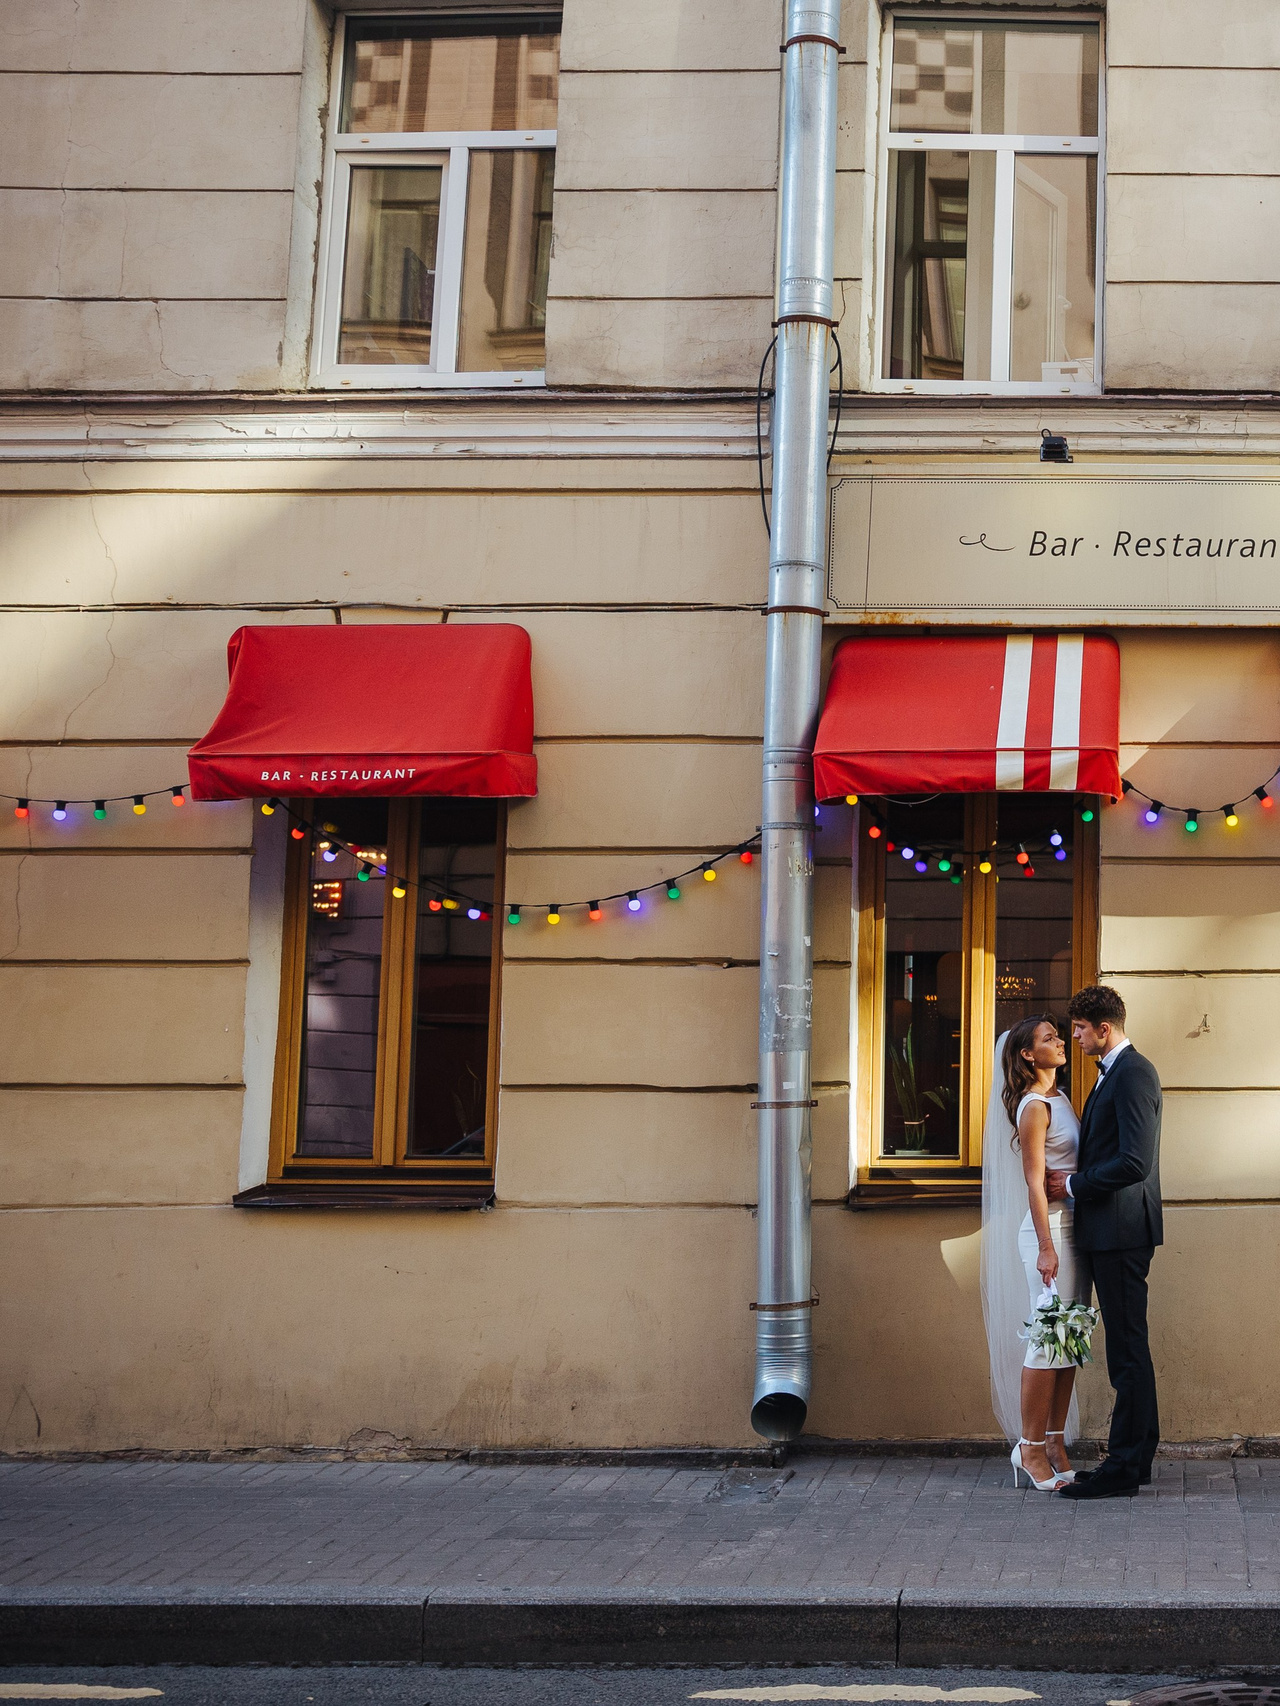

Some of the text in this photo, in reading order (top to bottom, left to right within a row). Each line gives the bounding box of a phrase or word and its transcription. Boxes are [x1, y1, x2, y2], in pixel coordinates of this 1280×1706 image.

[1028, 530, 1085, 557] Bar
[260, 768, 416, 781] BAR RESTAURANT
